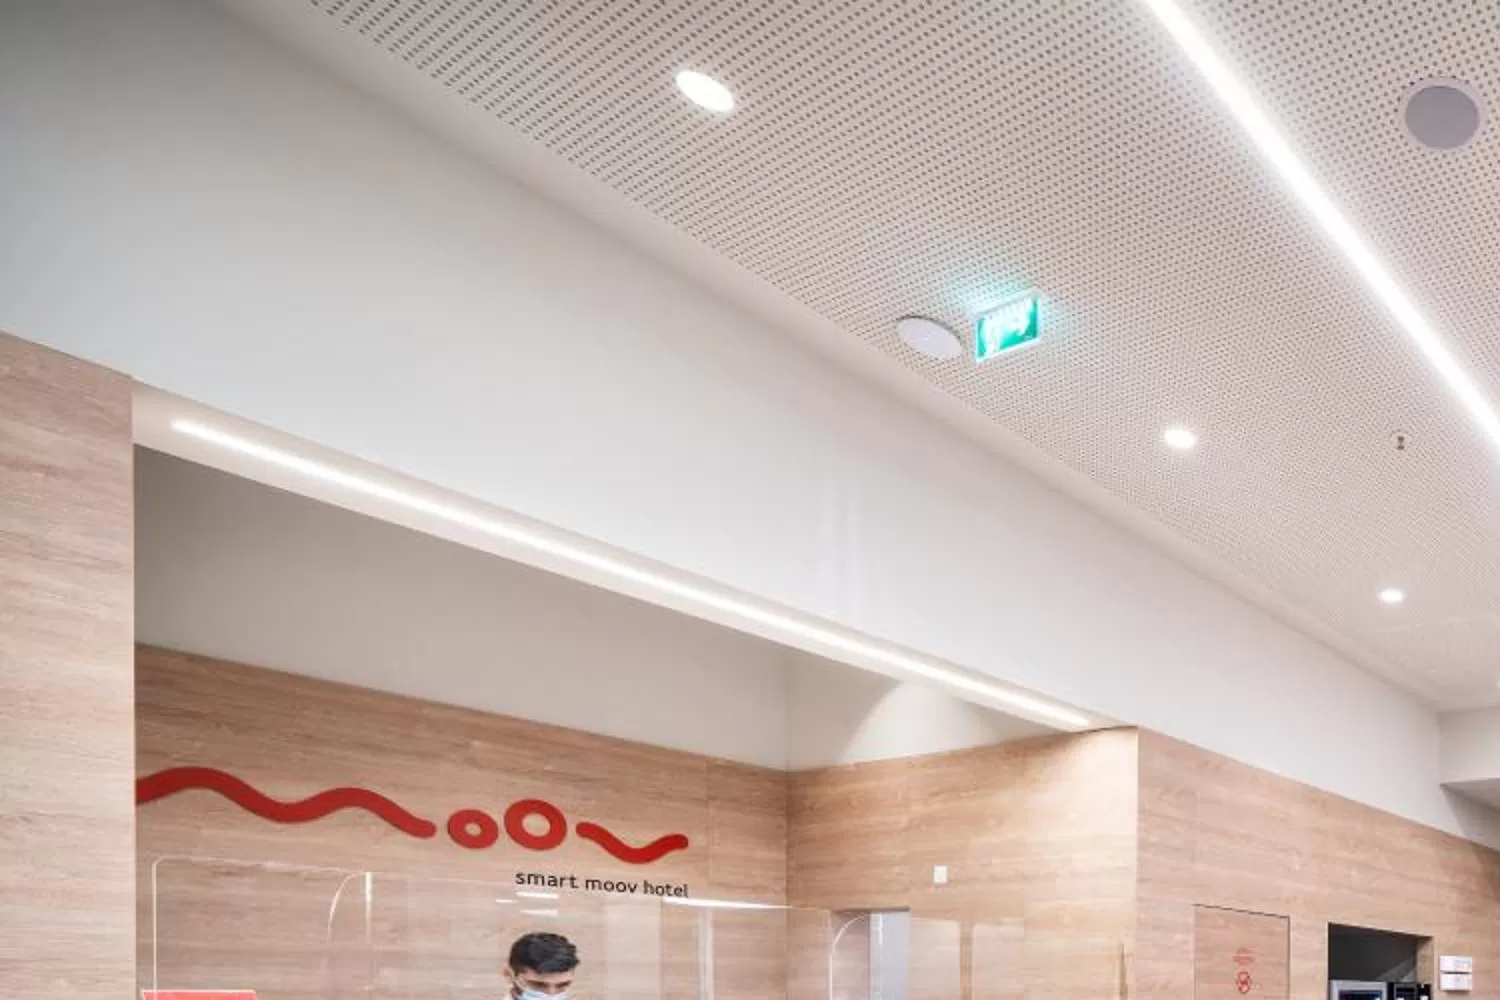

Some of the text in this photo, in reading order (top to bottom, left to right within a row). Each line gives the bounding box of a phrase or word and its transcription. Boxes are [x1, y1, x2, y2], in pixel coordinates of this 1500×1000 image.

[515, 871, 689, 898] smart moov hotel
